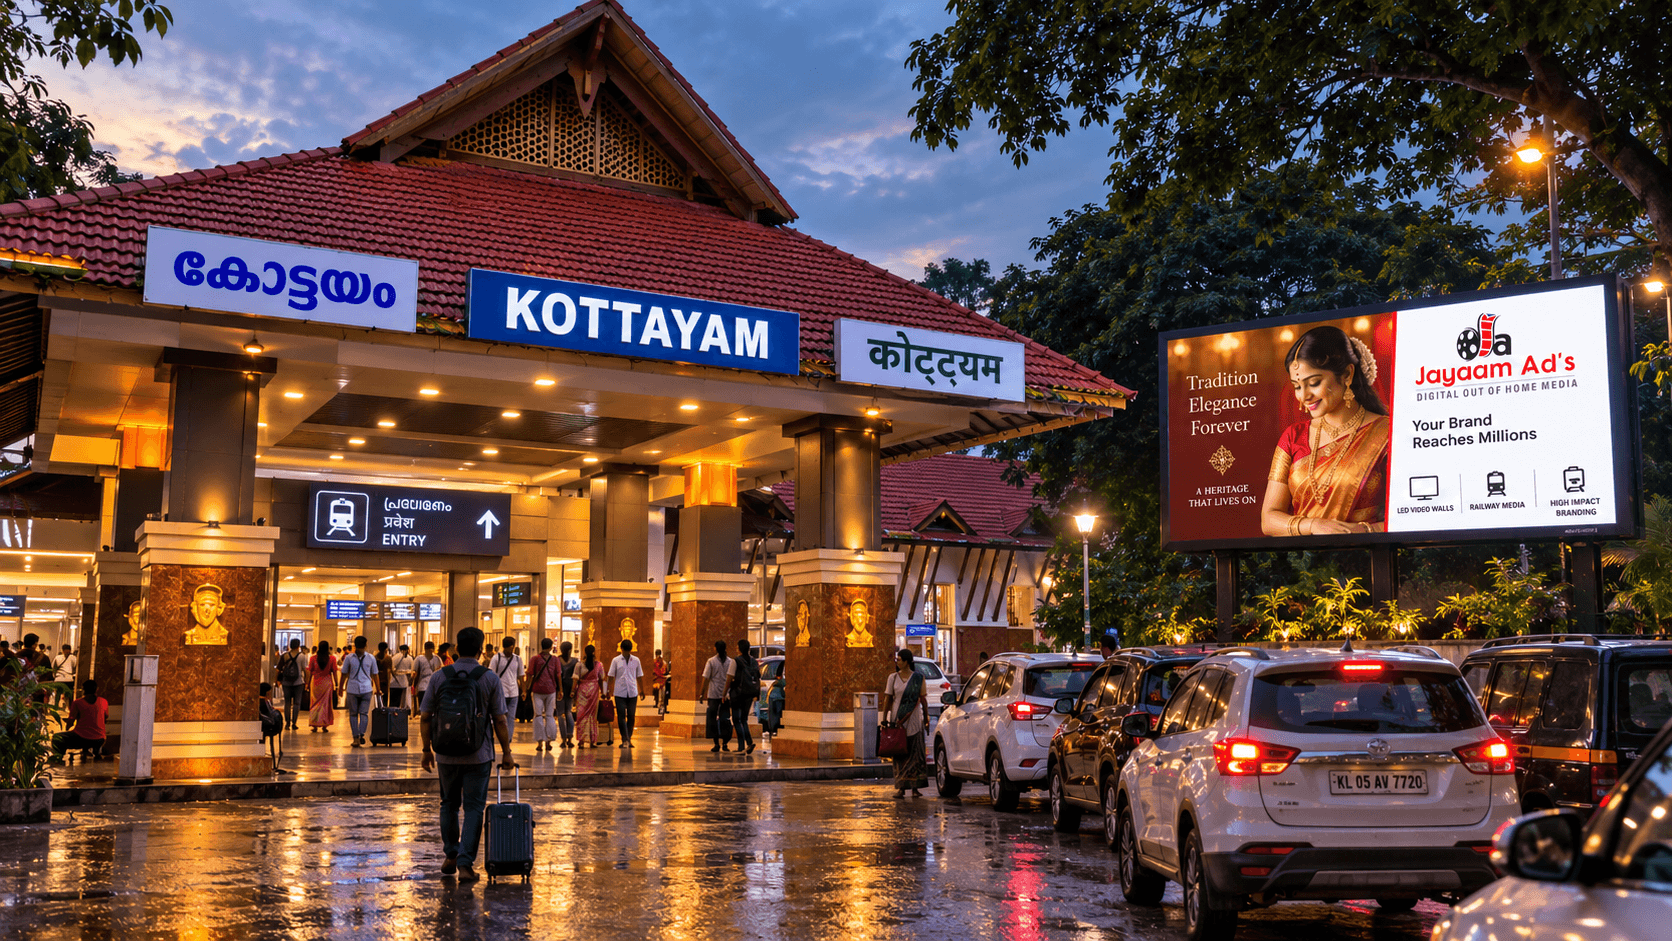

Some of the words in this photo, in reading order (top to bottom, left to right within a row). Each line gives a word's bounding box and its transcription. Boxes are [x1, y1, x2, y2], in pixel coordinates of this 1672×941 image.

[173, 250, 396, 311] കോട്ടയം
[505, 286, 769, 360] KOTTAYAM
[1415, 361, 1512, 388] Jayaam
[1520, 352, 1576, 376] Ad's
[1186, 371, 1259, 391] Tradition
[1416, 389, 1459, 402] DIGITAL
[1463, 387, 1484, 397] OUT
[1488, 385, 1501, 395] OF
[1505, 382, 1537, 393] HOME
[1541, 379, 1578, 391] MEDIA
[1189, 396, 1257, 416] Elegance
[1190, 419, 1251, 436] Forever
[1412, 420, 1445, 432] Your
[1448, 414, 1492, 429] Brand
[1413, 433, 1474, 449] Reaches
[1478, 427, 1538, 444] Millions
[1195, 487, 1202, 496] A
[1204, 484, 1249, 495] HERITAGE
[1188, 498, 1212, 508] THAT
[1214, 496, 1240, 507] LIVES
[1241, 495, 1256, 505] ON
[1410, 505, 1431, 513] VIDEO
[1432, 504, 1455, 512] WALLS
[1469, 502, 1501, 511] RAILWAY
[1502, 501, 1526, 509] MEDIA
[1550, 499, 1570, 507] HIGH
[1571, 497, 1601, 506] IMPACT
[383, 512, 416, 529] प्रवेश
[1555, 508, 1598, 517] BRANDING
[382, 533, 427, 547] ENTRY
[1337, 775, 1353, 789] KL
[1356, 775, 1371, 789] 05
[1374, 775, 1389, 789] AV
[1392, 775, 1423, 789] 7720
